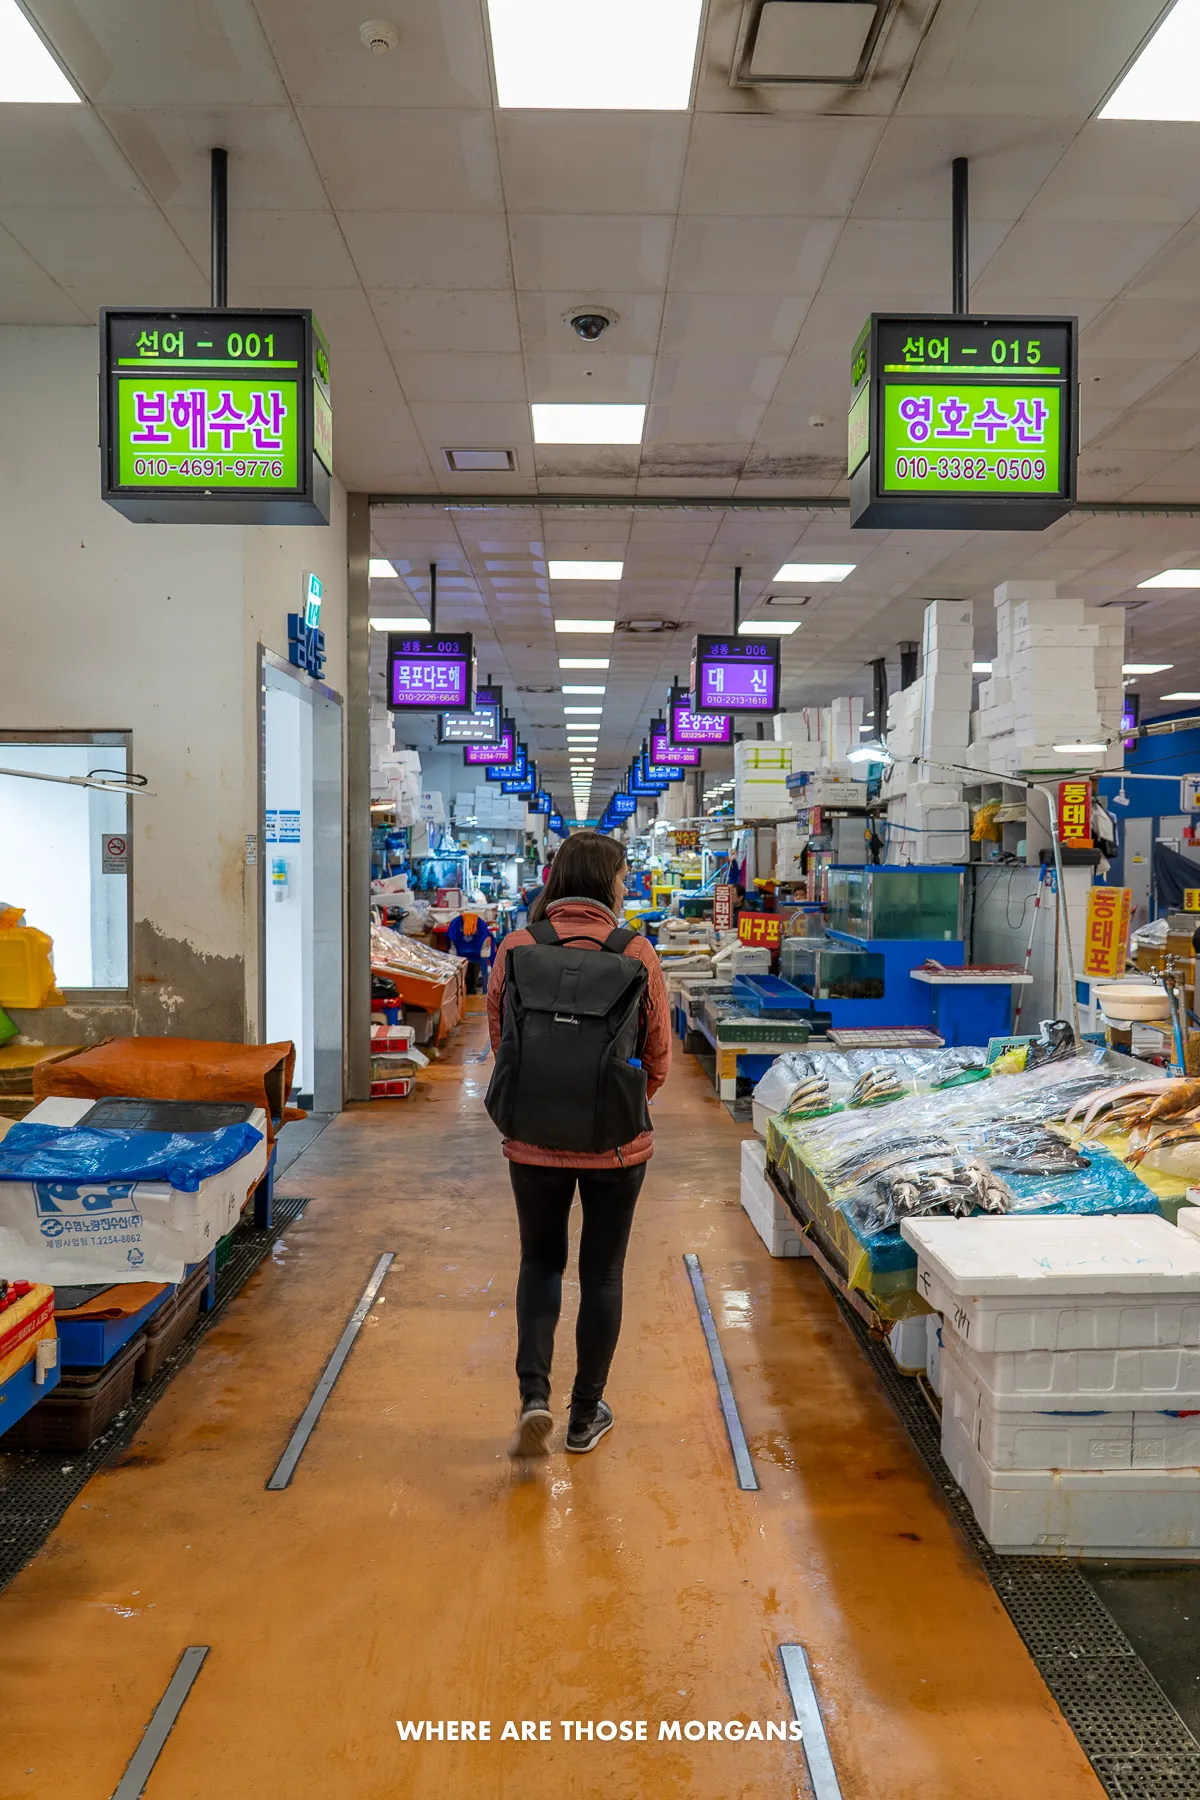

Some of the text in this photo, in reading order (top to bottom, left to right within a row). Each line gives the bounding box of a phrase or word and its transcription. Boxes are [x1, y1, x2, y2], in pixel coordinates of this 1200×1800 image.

[135, 330, 185, 358] 선어
[227, 332, 275, 358] 001
[901, 336, 950, 364] 선어
[991, 339, 1041, 364] 015
[131, 390, 287, 450] 보해수산
[899, 396, 1048, 443] 영호수산
[133, 458, 284, 478] 010-4691-9776
[895, 455, 1046, 481] 010-3382-0509
[438, 641, 460, 652] 003
[745, 645, 767, 655] 006
[706, 695, 768, 705] 010-2213-1618
[1062, 784, 1087, 840] 동태포
[715, 885, 729, 930] 동태포
[739, 917, 780, 941] 대구포
[1087, 890, 1116, 975] 동태포
